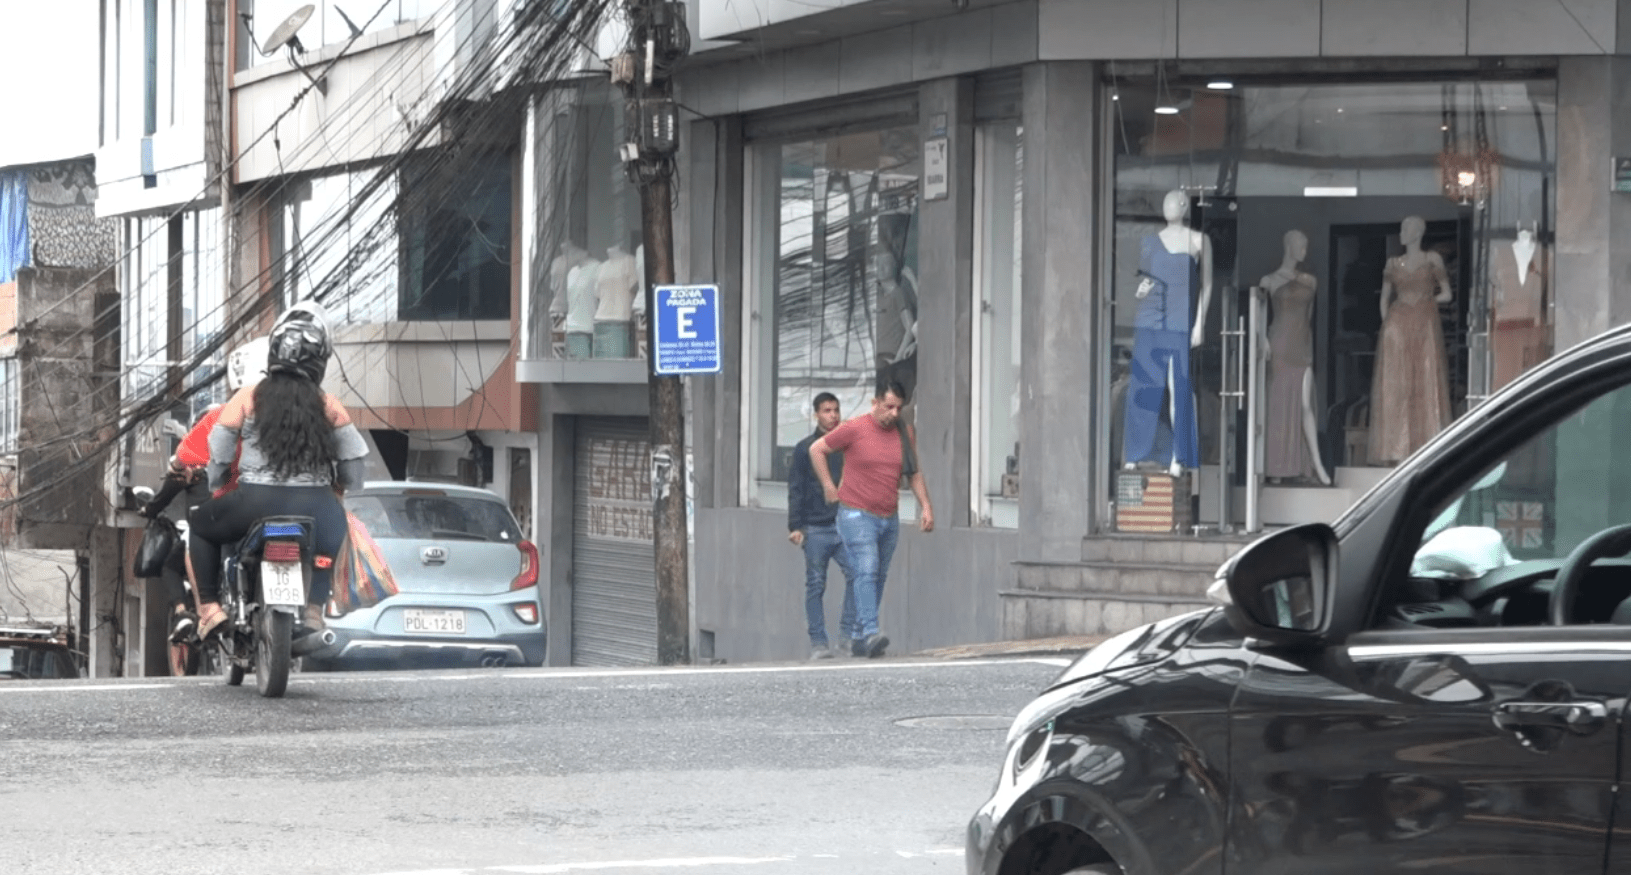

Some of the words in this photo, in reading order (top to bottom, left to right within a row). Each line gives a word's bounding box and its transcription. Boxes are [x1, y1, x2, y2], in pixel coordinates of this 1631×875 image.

[666, 298, 707, 307] PAGADA
[670, 289, 702, 298] ZONA
[677, 307, 697, 338] E
[591, 505, 607, 536] NO
